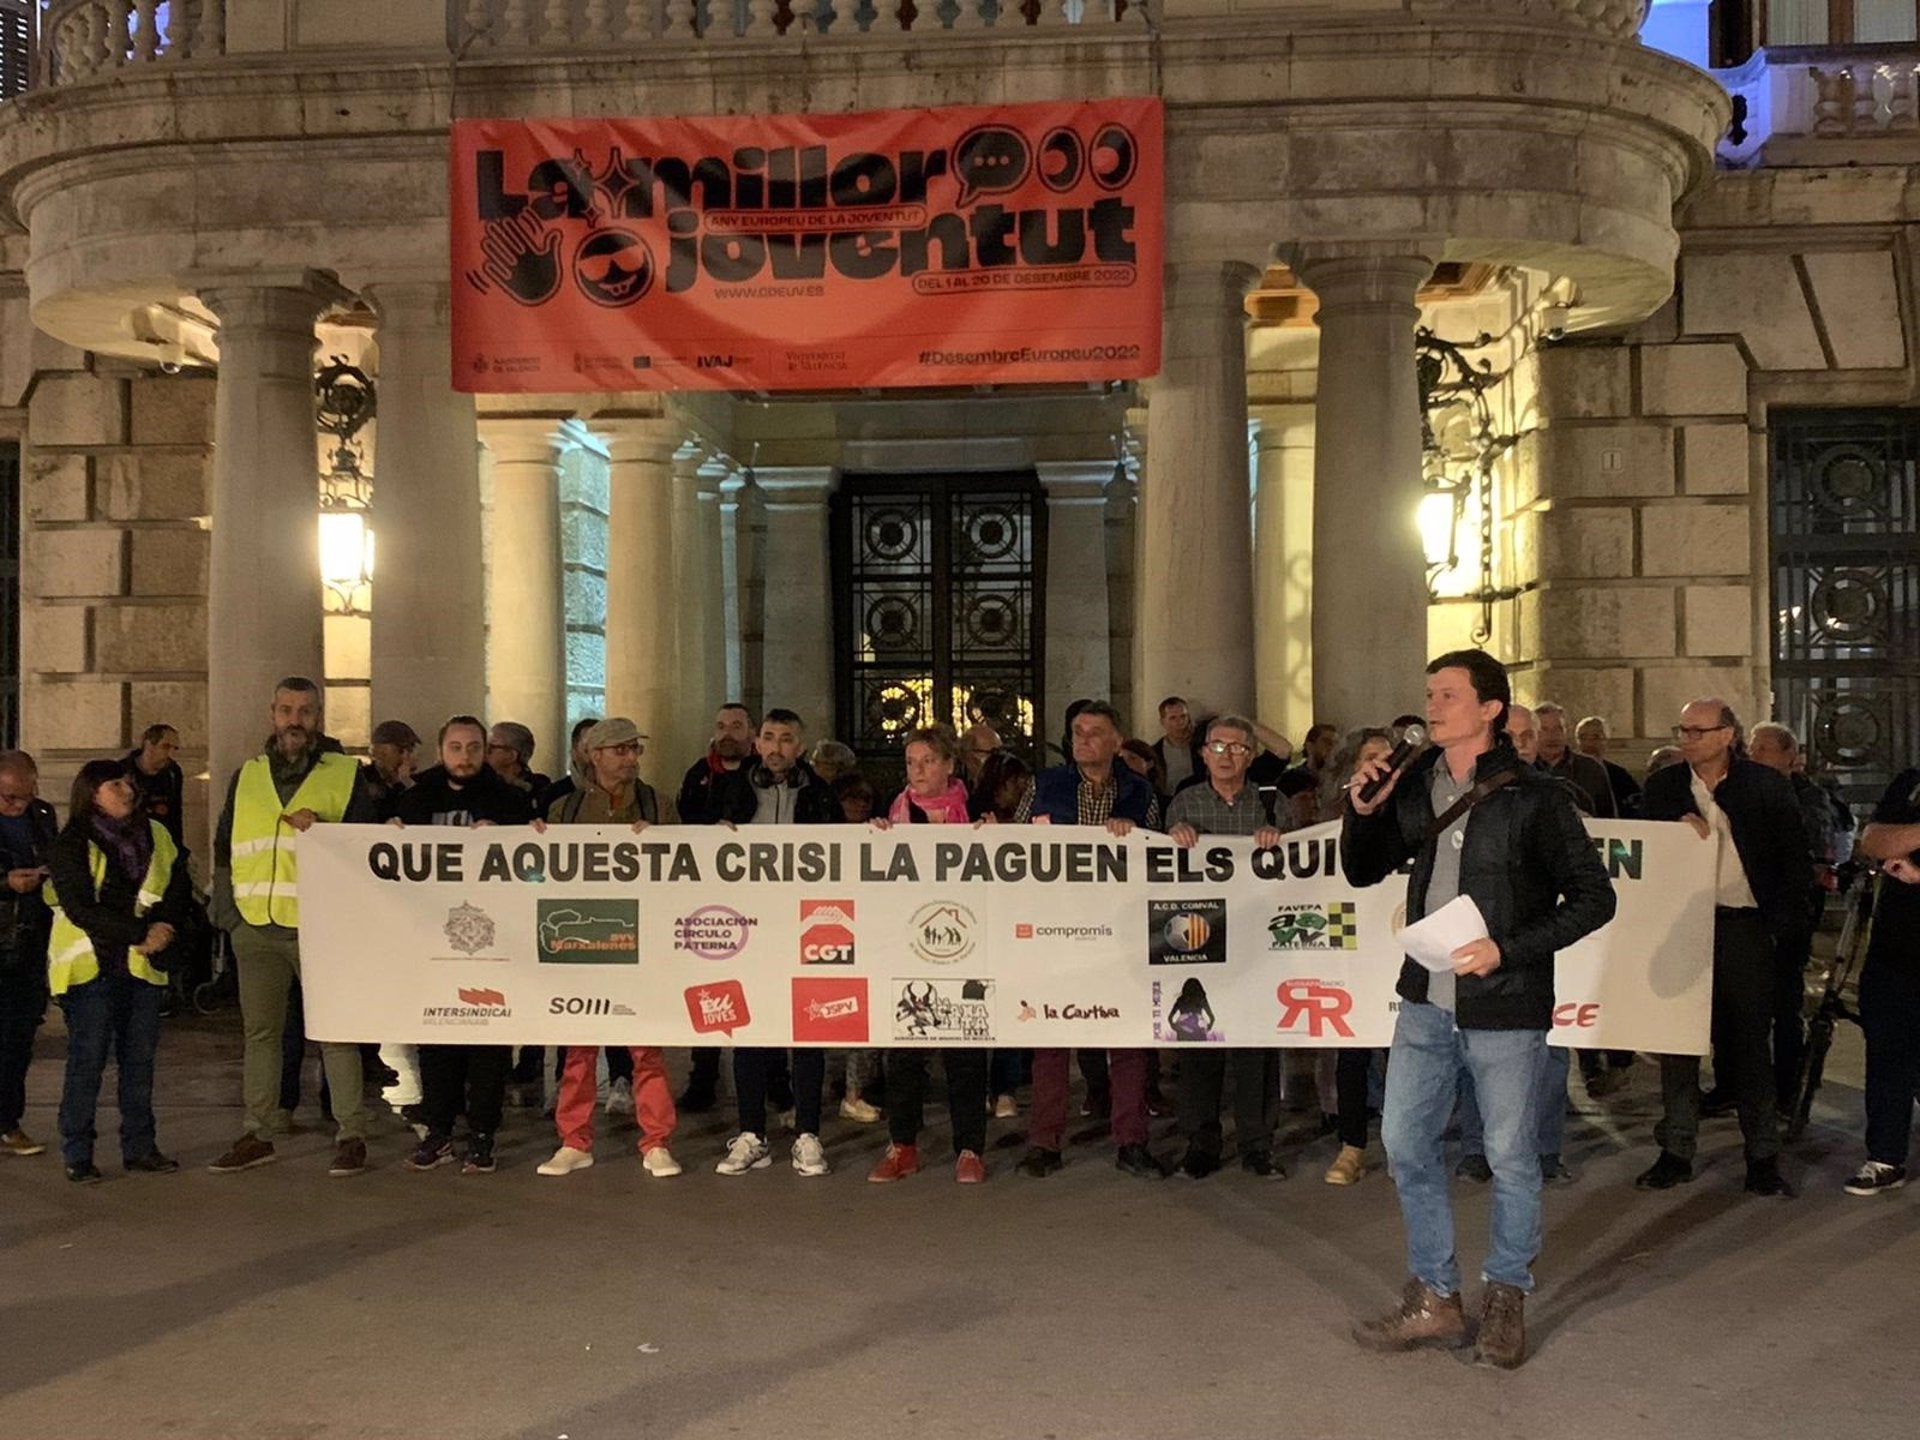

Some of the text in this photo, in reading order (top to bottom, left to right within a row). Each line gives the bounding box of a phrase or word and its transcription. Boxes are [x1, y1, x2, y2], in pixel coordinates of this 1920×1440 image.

[476, 145, 948, 220] La millor
[711, 211, 921, 227] ANY EUROPEU DE LA JOVENTUT
[918, 278, 943, 289] DEL
[953, 278, 969, 288] AL
[972, 276, 991, 287] 20
[993, 275, 1009, 285] DE
[1013, 271, 1092, 284] DESEMBRE
[1093, 269, 1130, 281] 2022
[697, 355, 734, 368] IVAJ
[918, 344, 1141, 365] #DesembreEuropeu2022
[368, 841, 464, 882] QUE
[478, 841, 702, 882] AQUESTA
[715, 842, 842, 882] CRISI
[859, 842, 920, 882] LA
[935, 842, 1128, 883] PAGUEN
[1145, 845, 1234, 882] ELS
[1278, 903, 1322, 912] FAVEPA
[674, 915, 758, 927] ASOCIACIÓN
[674, 940, 738, 951] PATERNA
[804, 944, 852, 962] CGT
[1044, 1004, 1060, 1020] la
